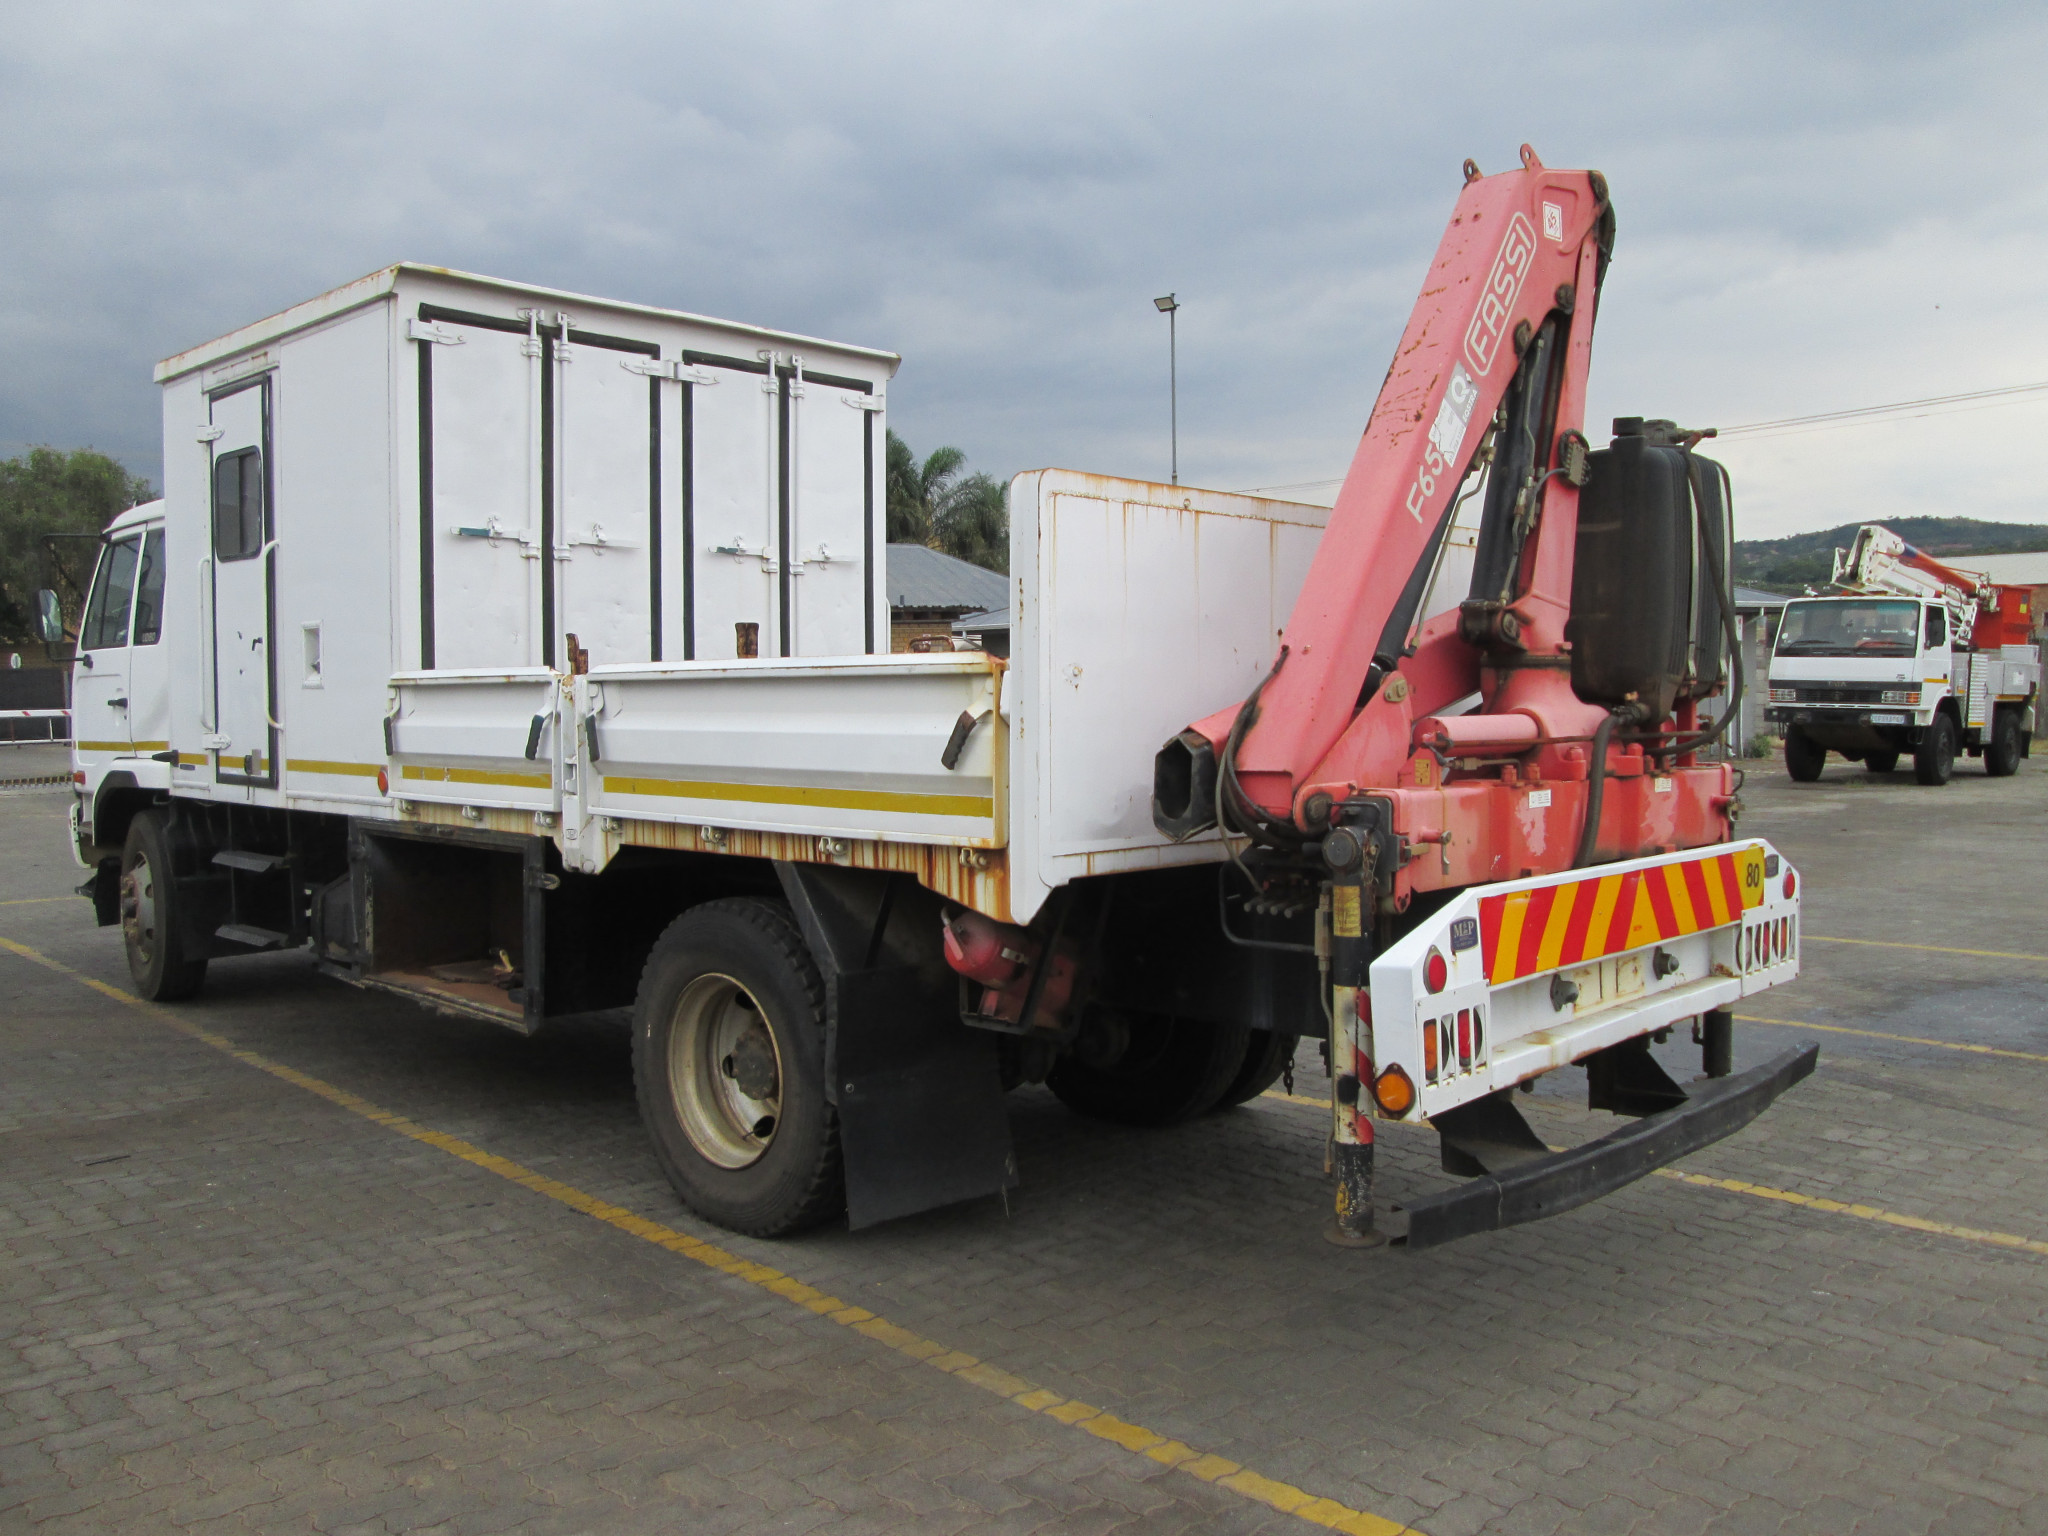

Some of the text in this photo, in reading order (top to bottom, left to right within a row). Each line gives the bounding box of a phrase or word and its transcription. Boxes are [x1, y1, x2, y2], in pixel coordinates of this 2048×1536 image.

[1470, 223, 1532, 364] FASSI
[1462, 389, 1478, 423] EQSTRA
[1406, 442, 1443, 524] F65
[1746, 863, 1760, 888] 80
